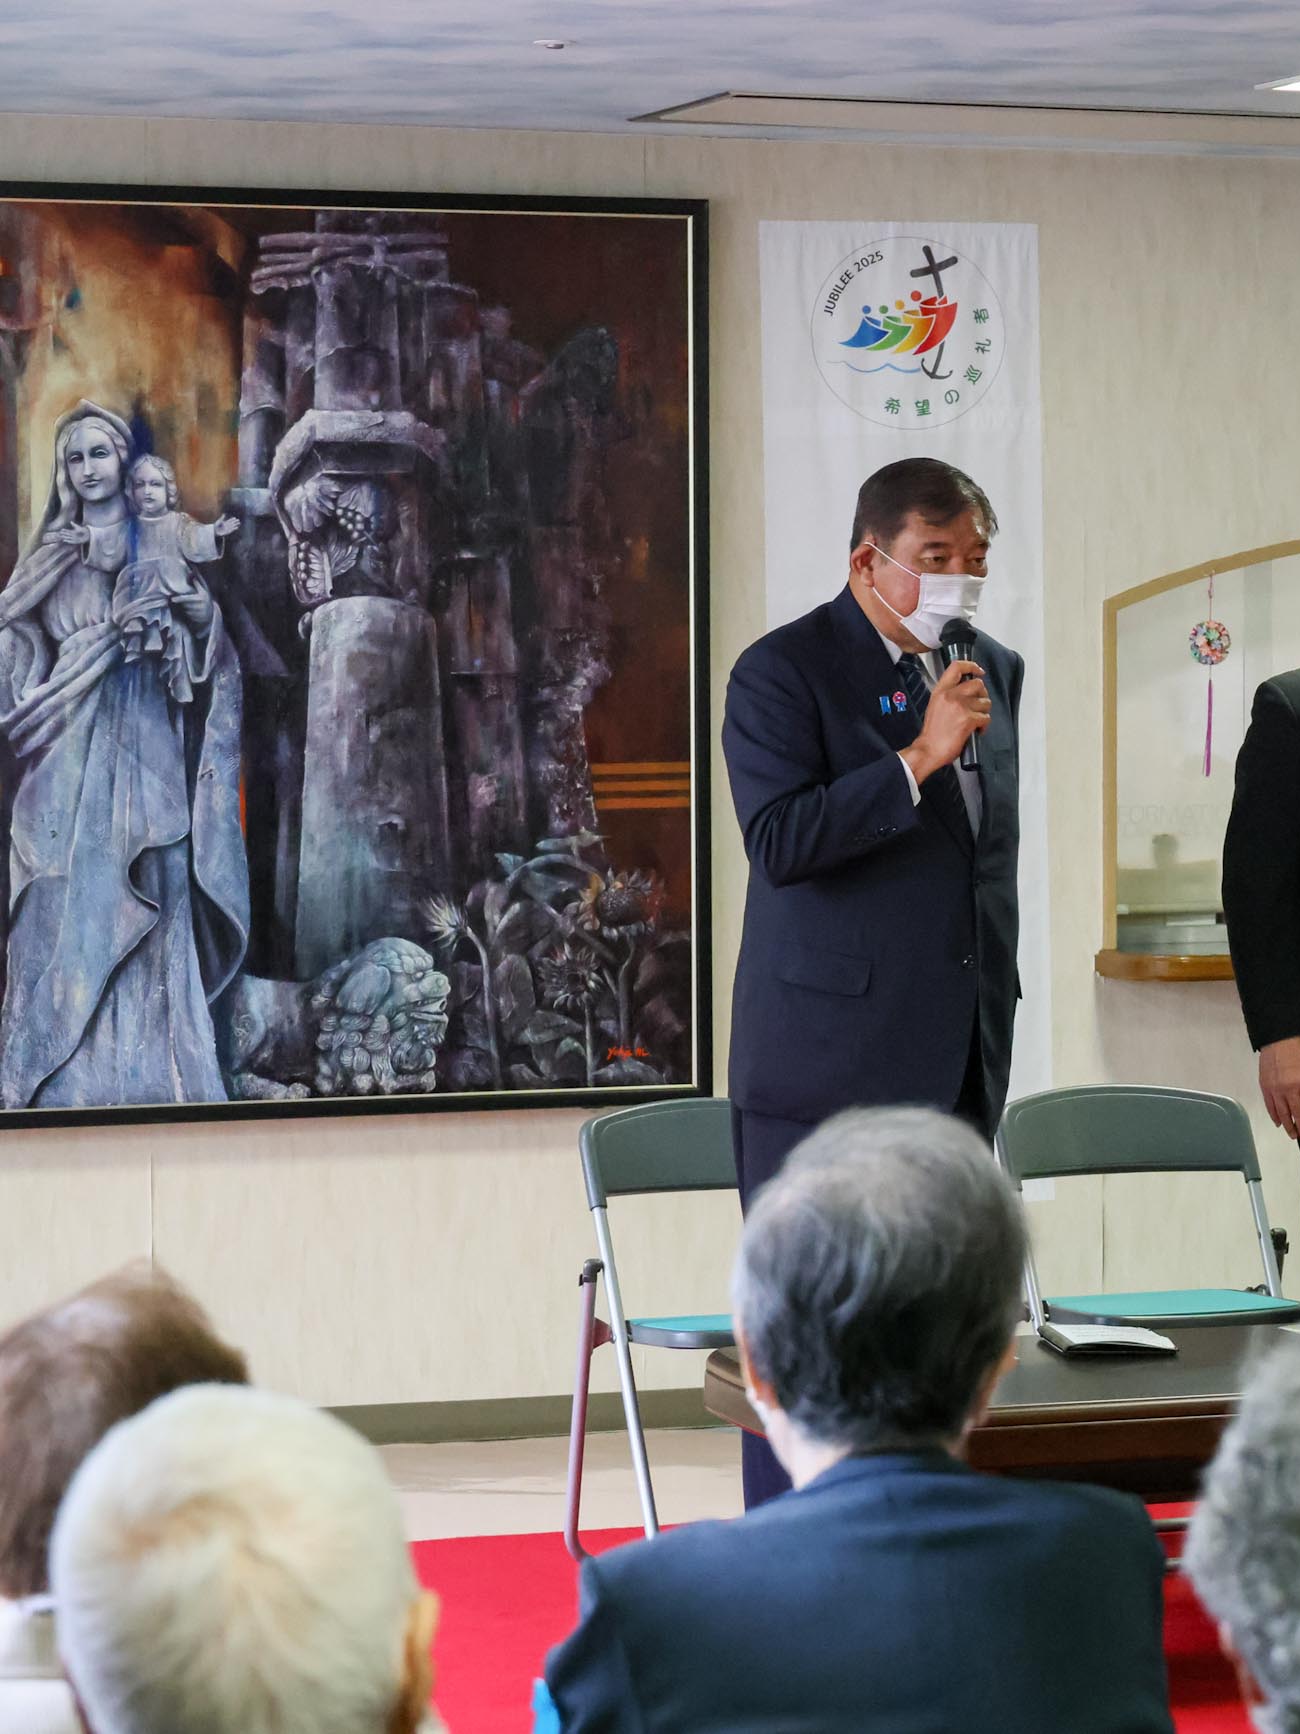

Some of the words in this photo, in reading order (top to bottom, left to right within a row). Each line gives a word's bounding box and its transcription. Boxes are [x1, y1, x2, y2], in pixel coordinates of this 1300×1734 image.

[823, 269, 854, 317] JUBILEE
[853, 250, 884, 273] 2025
[885, 308, 992, 417] 希望の巡礼者
